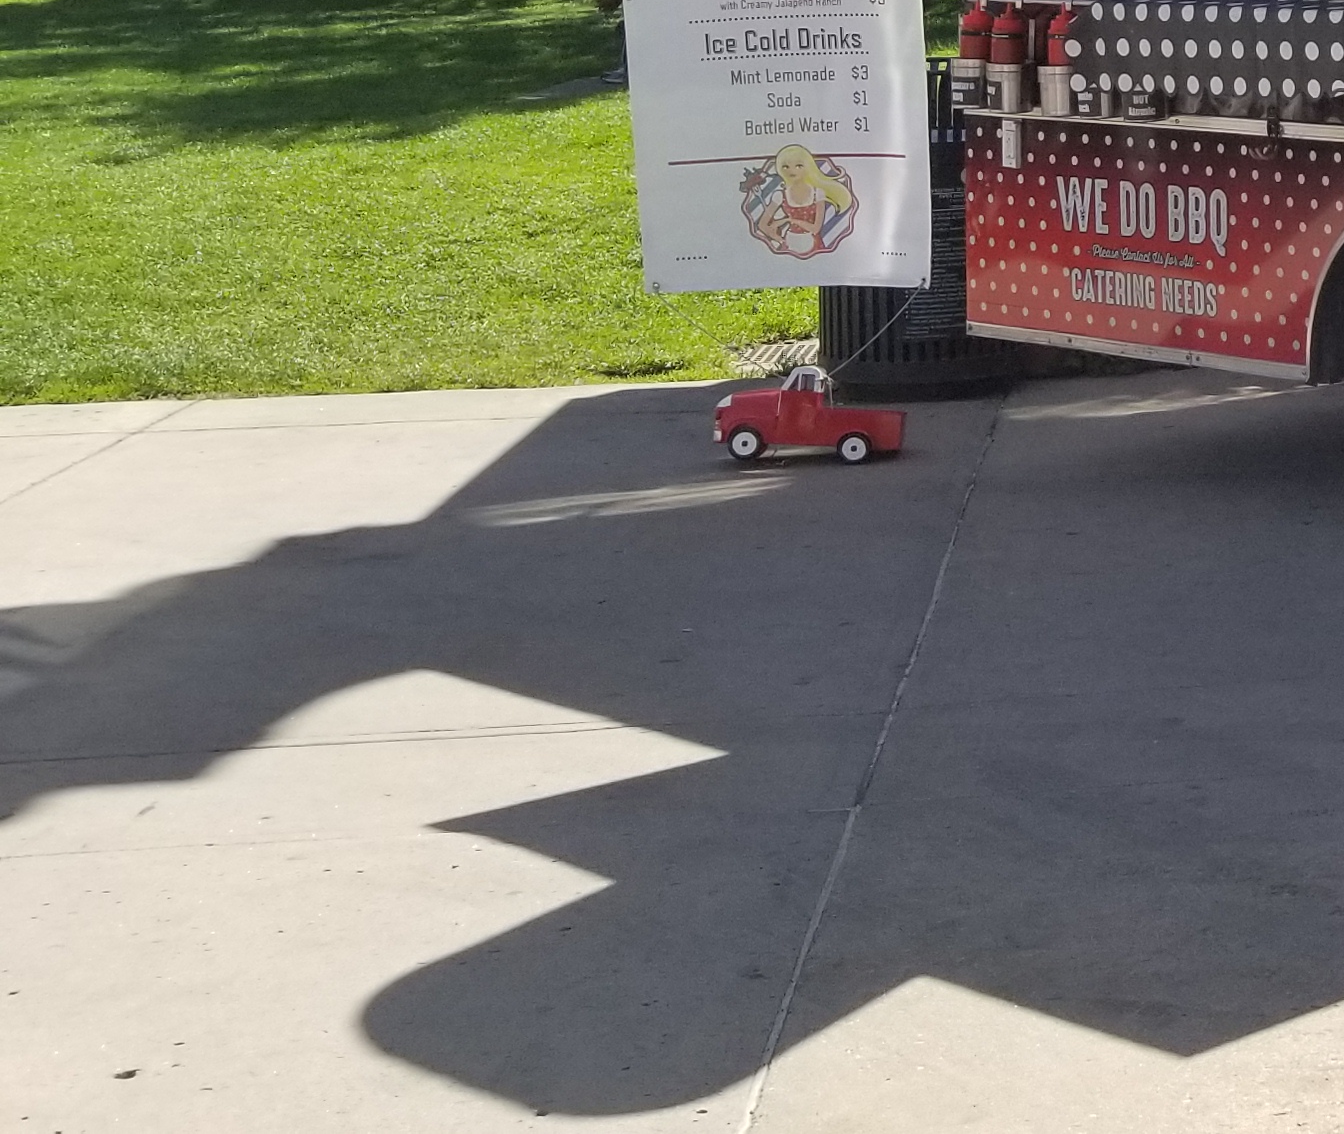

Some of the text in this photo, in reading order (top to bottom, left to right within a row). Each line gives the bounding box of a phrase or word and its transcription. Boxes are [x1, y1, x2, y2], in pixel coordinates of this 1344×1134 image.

[705, 27, 862, 55] Ice Cold Drinks
[730, 65, 869, 85] Mint Lemonade $3
[767, 90, 869, 108] Soda $1
[745, 117, 870, 135] Bottled Water $1
[1056, 176, 1228, 257] WE DO BBQ
[1092, 244, 1194, 268] Please Contact Us for All
[1071, 267, 1218, 317] CATERING NEEDS
